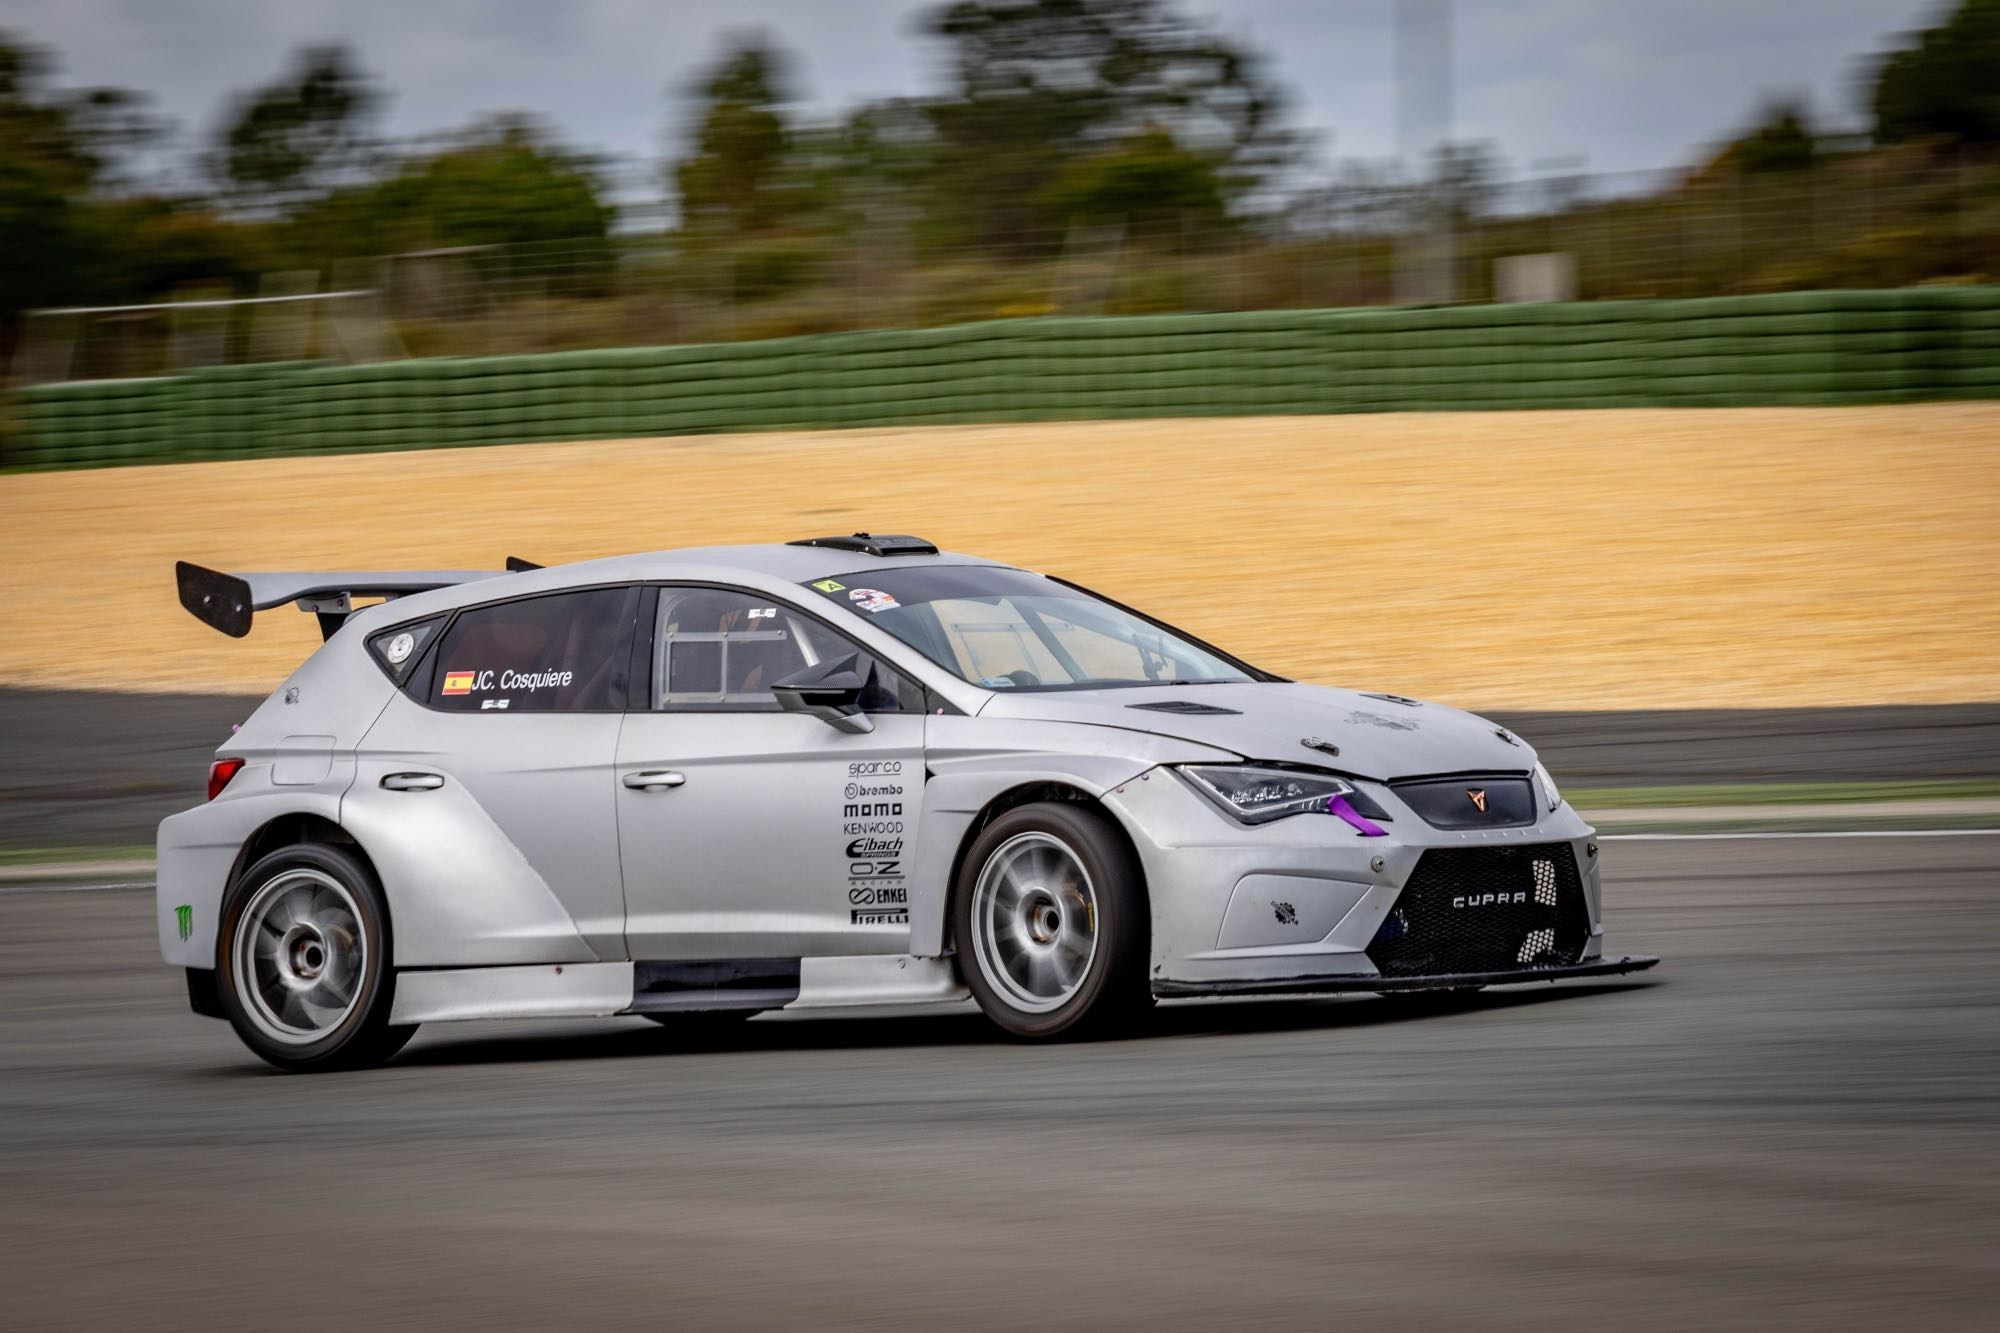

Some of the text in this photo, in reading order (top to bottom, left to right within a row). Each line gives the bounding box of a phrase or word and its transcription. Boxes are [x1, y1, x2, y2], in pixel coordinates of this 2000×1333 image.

[828, 583, 842, 591] A
[471, 667, 573, 693] JC. Cosquiere
[848, 761, 902, 778] sparco
[859, 784, 903, 796] brembo
[843, 821, 904, 836] KENWOOD
[846, 836, 904, 858] Eibach
[1453, 891, 1526, 909] CUPRA
[850, 907, 909, 926] PIRELLI
